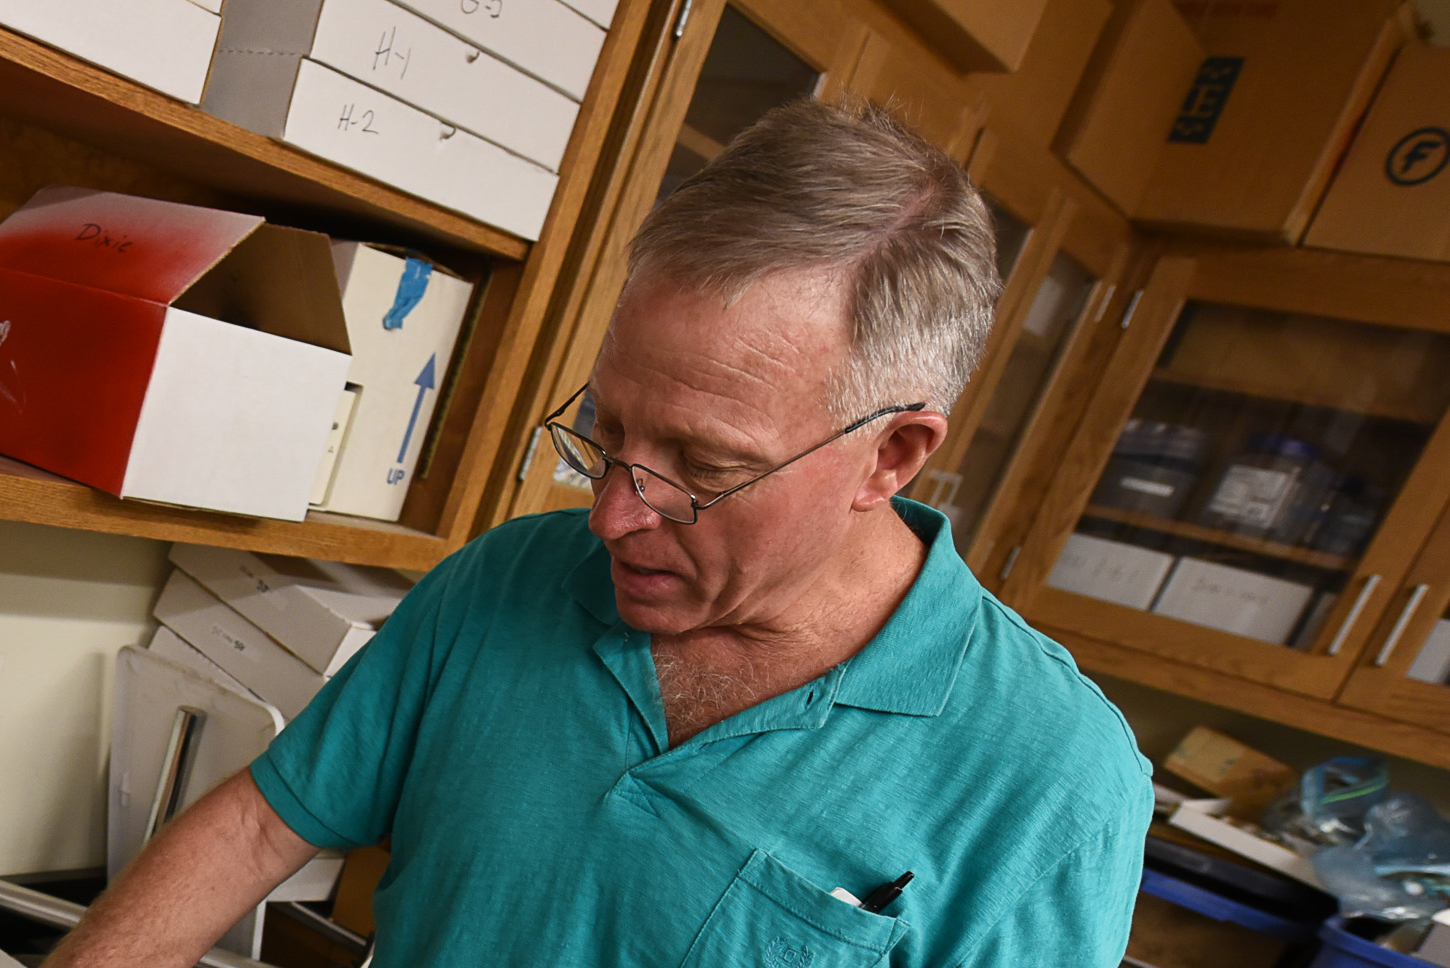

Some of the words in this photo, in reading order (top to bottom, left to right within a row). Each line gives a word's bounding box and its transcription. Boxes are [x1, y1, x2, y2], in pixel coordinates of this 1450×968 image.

[373, 26, 412, 80] H-1
[337, 104, 379, 134] H-2
[75, 223, 134, 253] Dixie
[386, 468, 406, 485] UP
